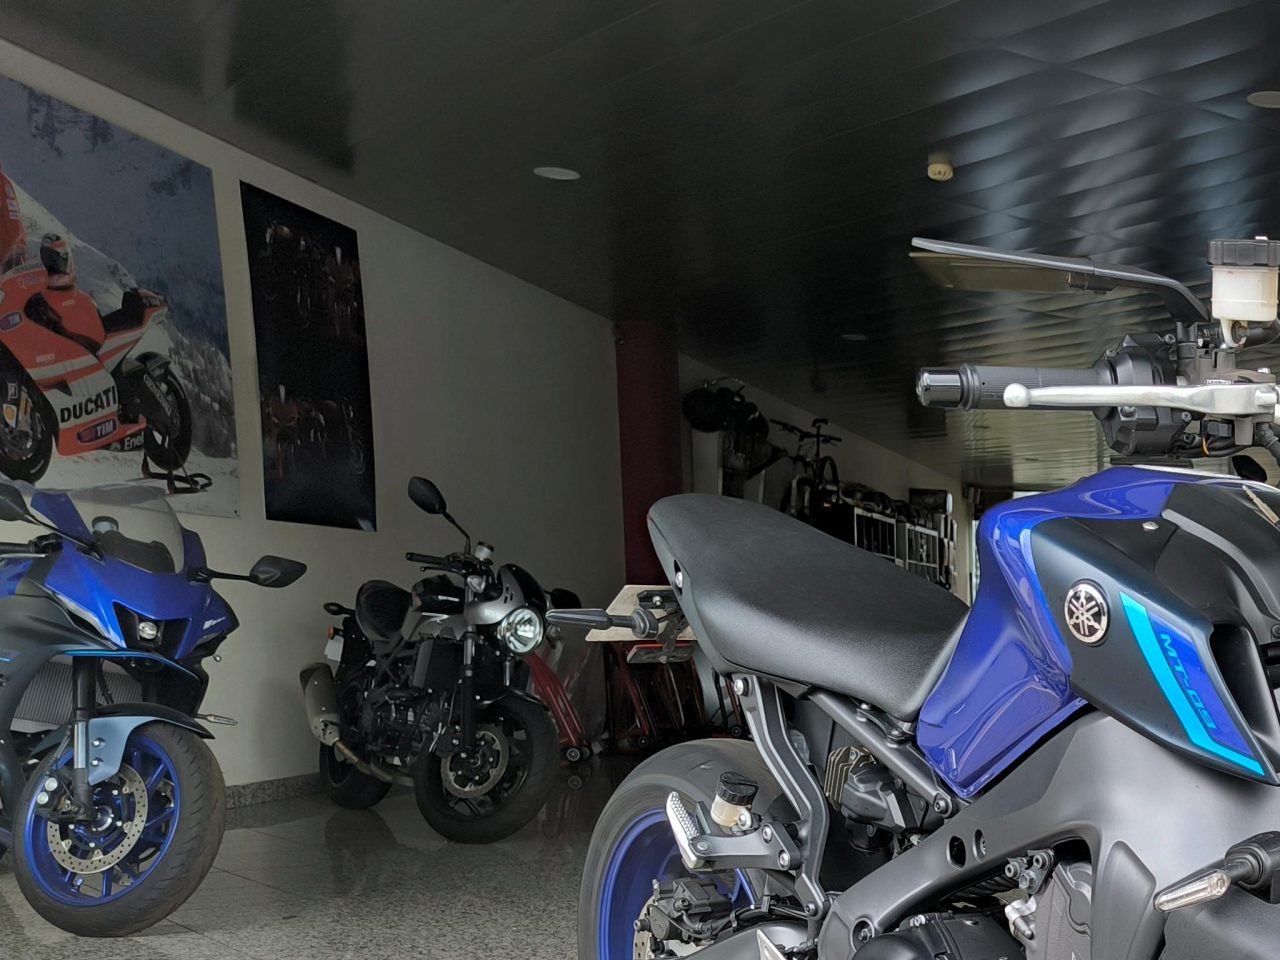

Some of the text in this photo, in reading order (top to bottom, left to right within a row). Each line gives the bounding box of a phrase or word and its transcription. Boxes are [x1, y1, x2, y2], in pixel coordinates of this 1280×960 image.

[60, 386, 118, 424] DUCATI
[96, 420, 115, 438] TIM
[124, 431, 144, 450] Enel
[1160, 632, 1218, 730] MT-09
